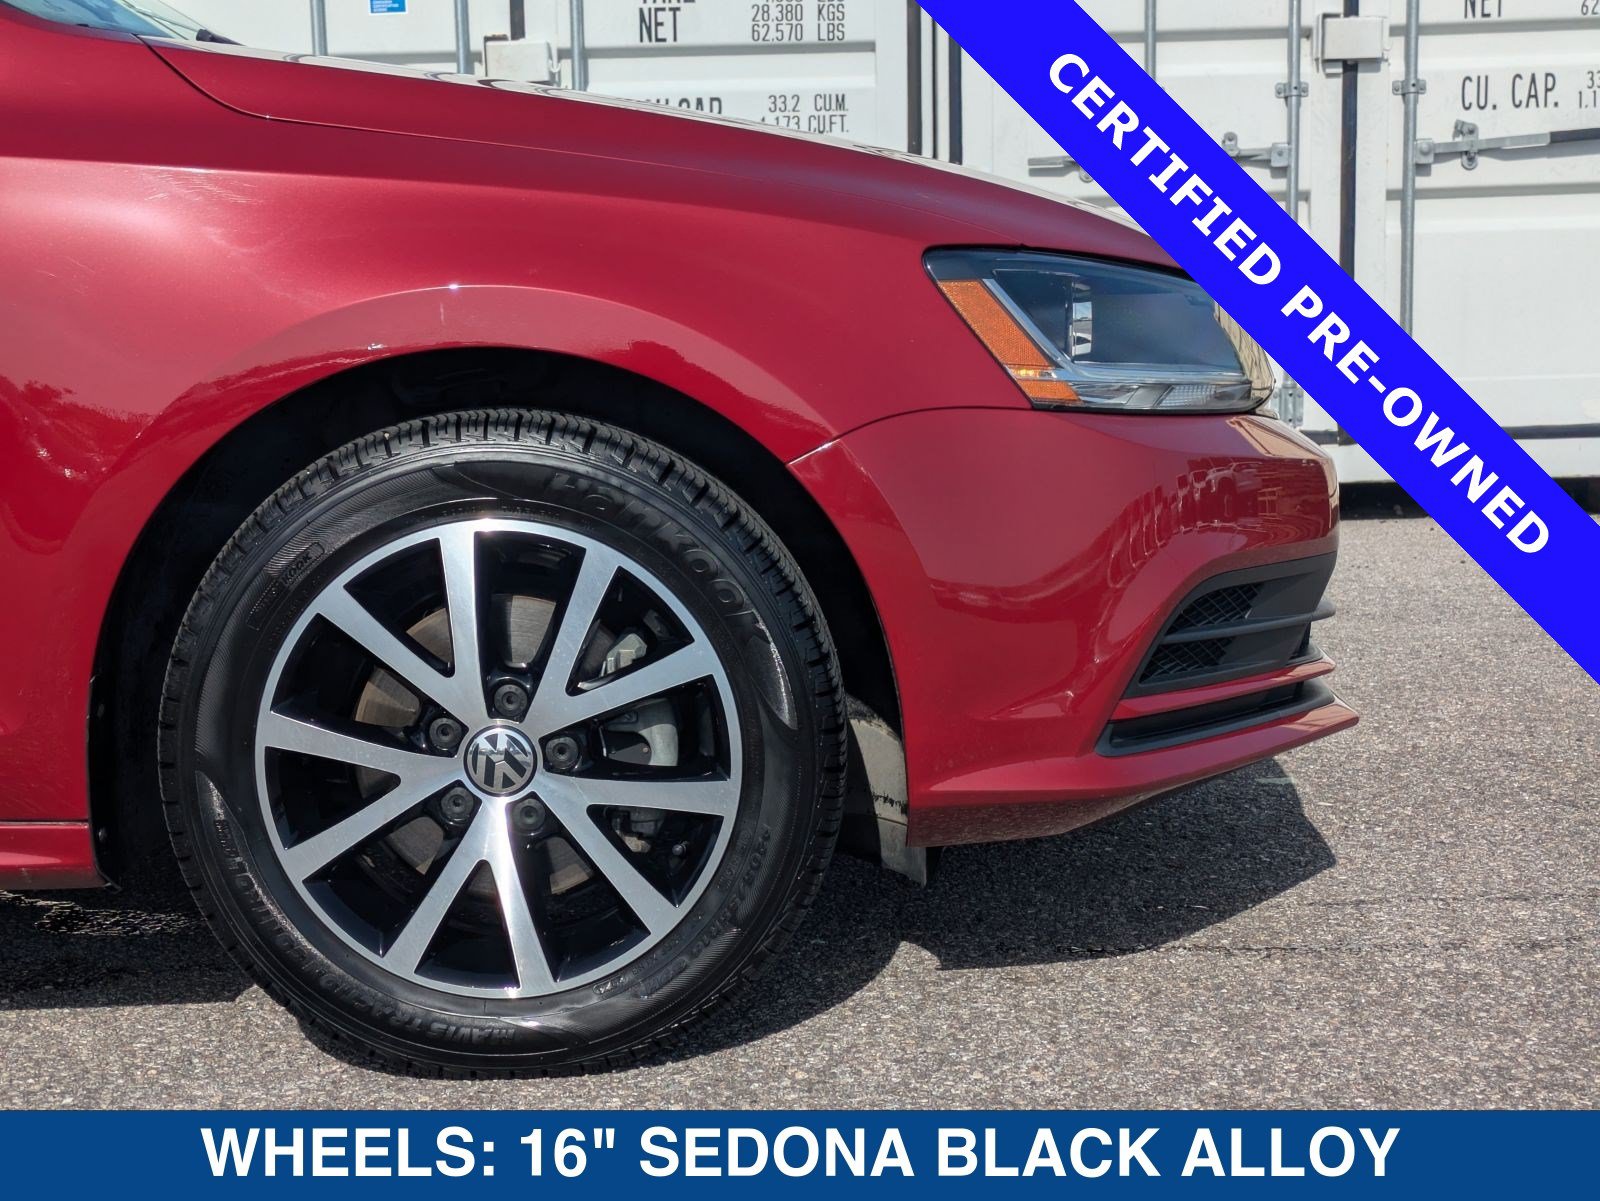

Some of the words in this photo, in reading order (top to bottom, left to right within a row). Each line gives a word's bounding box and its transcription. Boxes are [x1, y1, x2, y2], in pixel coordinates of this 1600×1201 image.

[751, 4, 804, 23] 28.380
[817, 3, 846, 22] KGS
[639, 7, 681, 43] NET
[751, 23, 804, 42] 62.570
[817, 22, 846, 41] LBS
[1461, 74, 1498, 110] CU.
[1511, 72, 1560, 108] CAP.
[768, 94, 801, 113] 33.2
